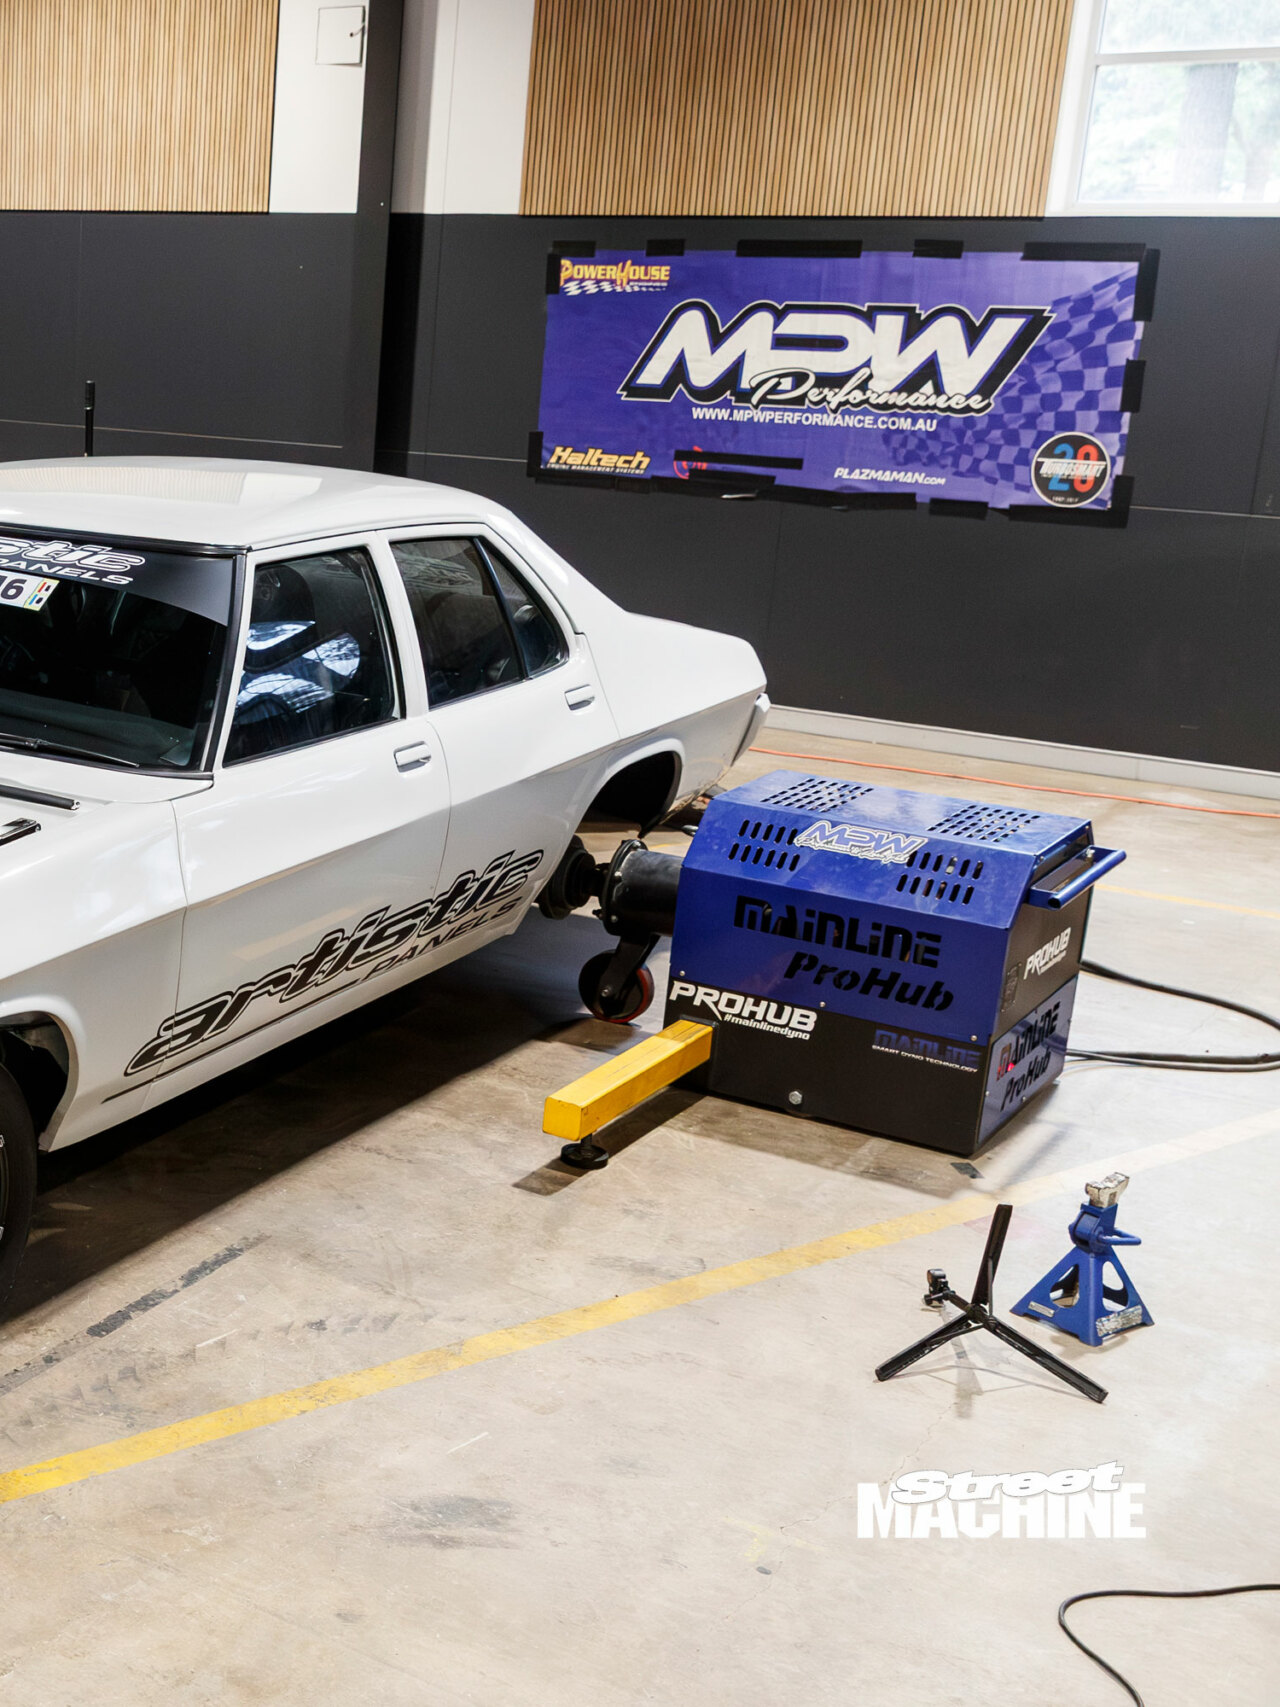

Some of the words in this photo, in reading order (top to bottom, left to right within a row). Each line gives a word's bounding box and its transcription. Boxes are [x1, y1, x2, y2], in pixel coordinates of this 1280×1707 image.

[623, 302, 1045, 398] MPW
[749, 367, 992, 409] Performance
[692, 407, 937, 431] WWW.MPWPERFORMANCE.COM.AU
[549, 445, 651, 469] Haltech
[800, 821, 927, 855] MPW
[361, 896, 523, 981] PANELS
[1024, 927, 1071, 980] PROHUB
[124, 849, 544, 1077] artistic
[783, 951, 954, 1011] ProHub
[669, 980, 818, 1032] PROHUB
[724, 1014, 811, 1040] #mainlinedyno
[901, 1051, 924, 1060] DYNO
[926, 1057, 978, 1072] TECHNOLOGY
